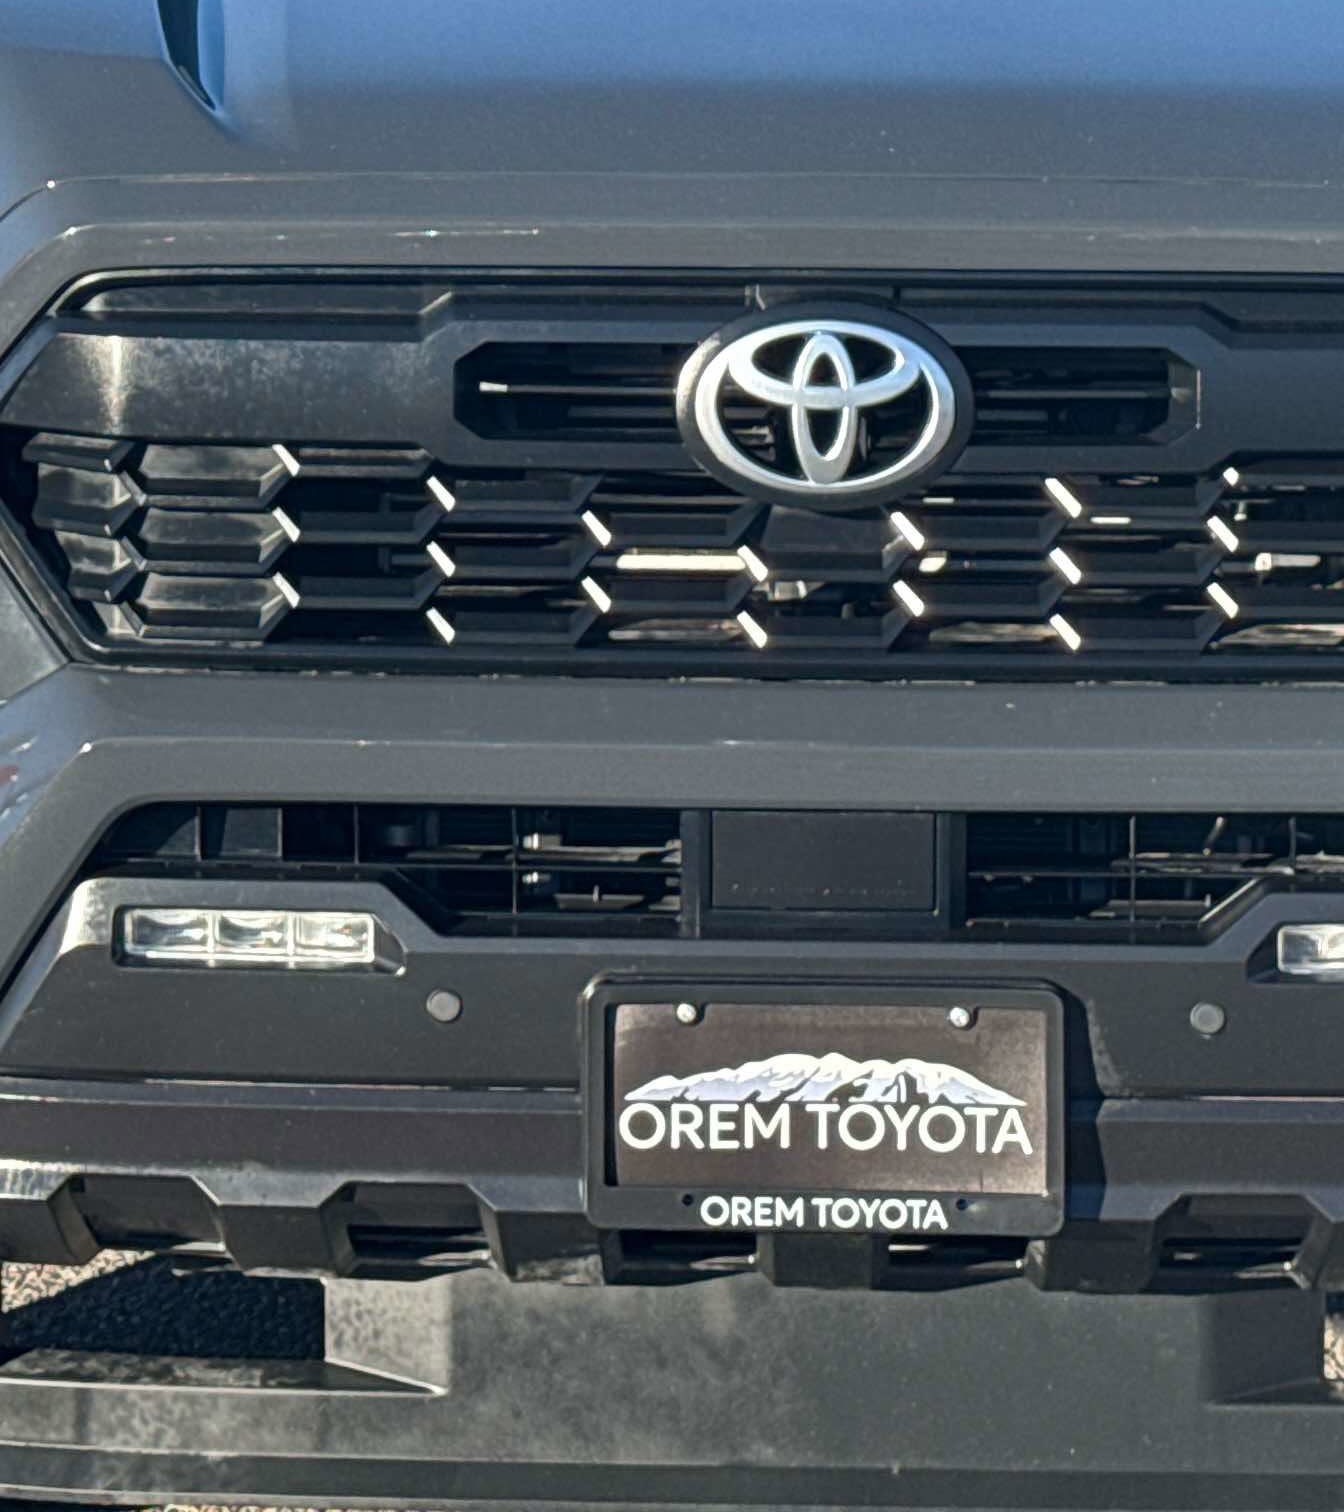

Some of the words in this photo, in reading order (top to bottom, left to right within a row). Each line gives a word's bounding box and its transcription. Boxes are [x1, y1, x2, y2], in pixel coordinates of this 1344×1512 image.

[618, 1102, 791, 1150] OREM
[805, 1103, 1034, 1156] TOYOTA
[700, 1195, 805, 1228] OREM
[811, 1197, 949, 1230] TOYOTA
